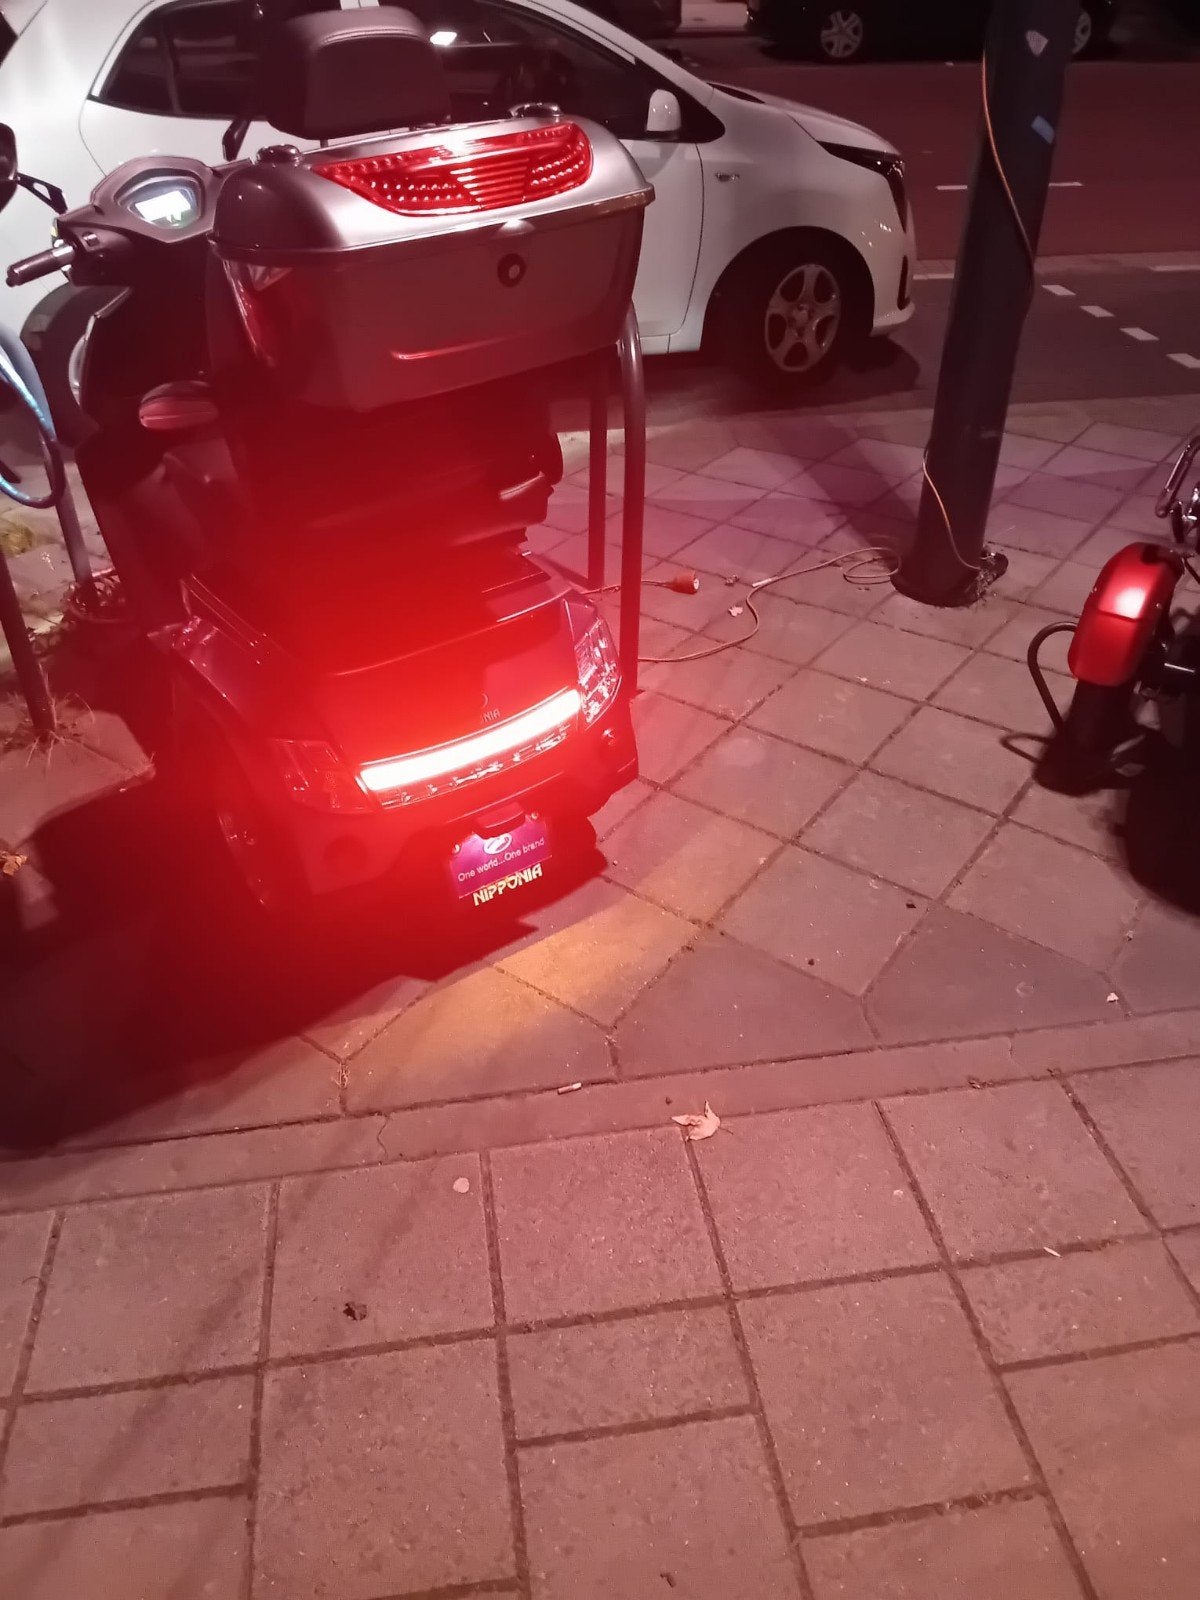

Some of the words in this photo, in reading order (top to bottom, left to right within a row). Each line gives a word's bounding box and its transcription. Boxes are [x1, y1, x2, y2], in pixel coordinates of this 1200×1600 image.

[458, 869, 476, 882] One
[522, 837, 545, 854] brand
[472, 863, 543, 907] NIPPONIA
